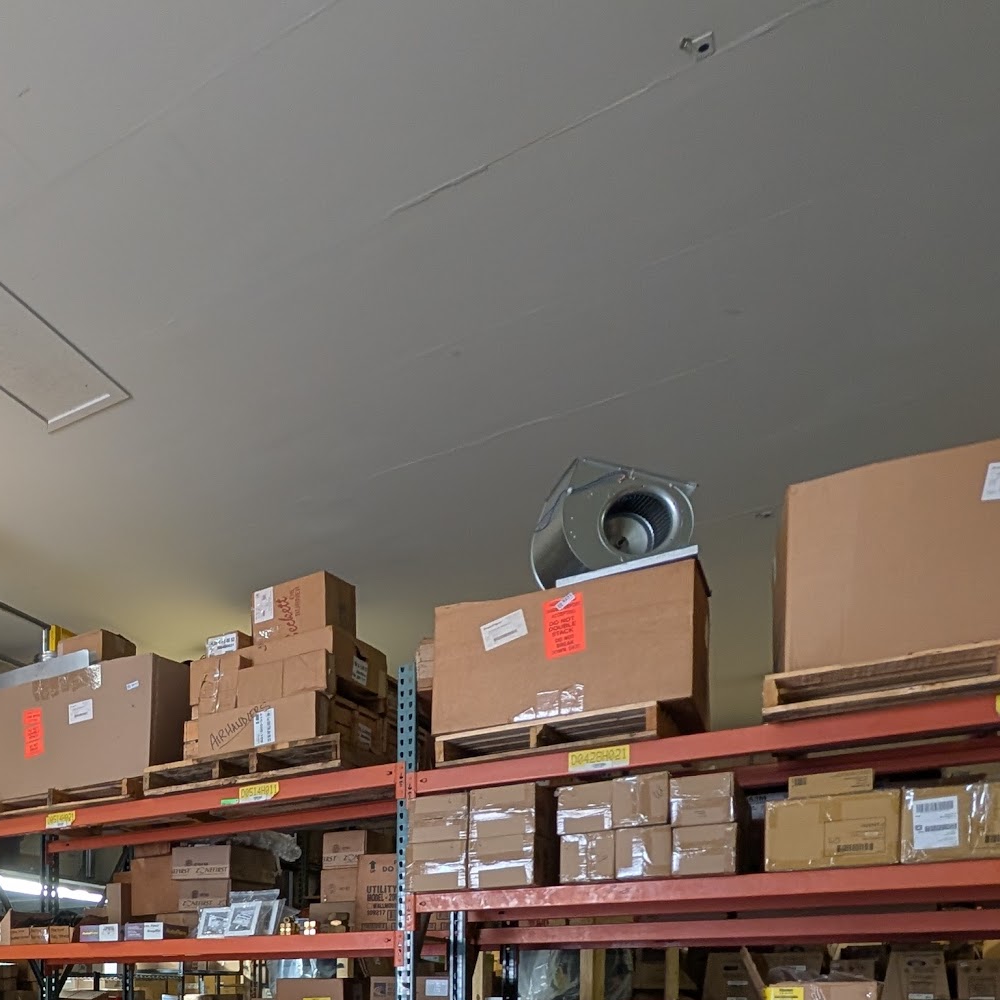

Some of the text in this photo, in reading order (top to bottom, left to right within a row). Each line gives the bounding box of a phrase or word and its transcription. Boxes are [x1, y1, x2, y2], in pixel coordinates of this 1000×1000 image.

[276, 596, 298, 637] eckett
[548, 621, 576, 632] DOUBLE
[551, 628, 574, 637] STACK
[366, 884, 397, 893] UTILITY
